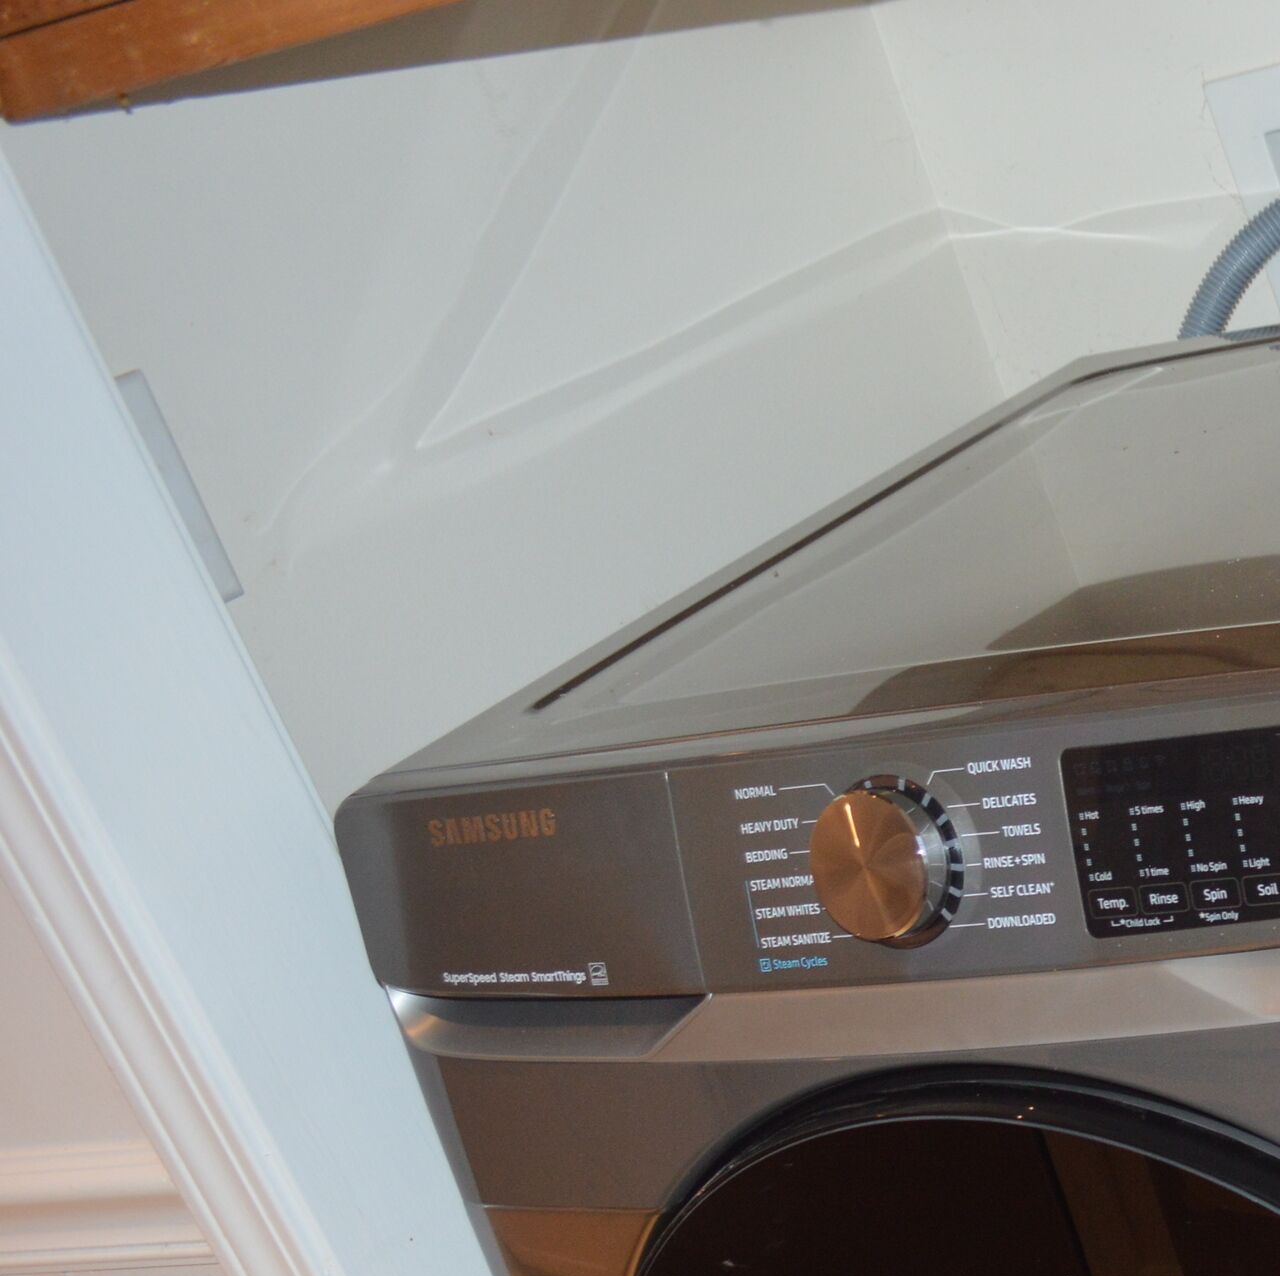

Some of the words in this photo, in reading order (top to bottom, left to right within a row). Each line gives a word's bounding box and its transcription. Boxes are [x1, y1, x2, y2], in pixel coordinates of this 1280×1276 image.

[967, 760, 1000, 776] QUICK
[1000, 757, 1031, 771] WASH
[734, 785, 776, 800] NORMAL
[982, 793, 1036, 810] DELICATES
[1186, 799, 1206, 812] High
[1238, 795, 1264, 806] Heavy
[1084, 811, 1099, 820] Hot
[1141, 804, 1164, 815] times
[428, 808, 557, 847] SAMSUNG
[740, 821, 772, 835] HEAVY
[774, 818, 799, 831] DUTY
[1002, 823, 1041, 838] TOWELS
[746, 848, 788, 863] BEDDING
[1196, 863, 1209, 873] No
[1209, 861, 1227, 873] Spin
[1248, 857, 1270, 869] Light
[1094, 872, 1112, 882] Cold
[1150, 866, 1170, 877] time
[751, 877, 781, 892] STEAM
[782, 875, 814, 888] NORMA
[1257, 883, 1279, 896] Soil
[990, 885, 1015, 899] SELF
[1149, 892, 1178, 906] Rinse
[1203, 888, 1228, 902] Spin
[1097, 897, 1129, 911] Temp.
[756, 906, 786, 920] STEAM
[787, 903, 820, 917] WHITES
[1221, 910, 1239, 921] Only
[987, 913, 1056, 929] DOWNLOADED
[1144, 917, 1161, 927] Lock
[761, 936, 792, 949] STEAM
[792, 932, 832, 946] SANITIZE
[773, 958, 800, 970] Steam
[800, 956, 828, 969] Cycles
[443, 972, 497, 986] SuperSpeed
[500, 972, 529, 983] Steam
[531, 970, 586, 985] SmartThings
